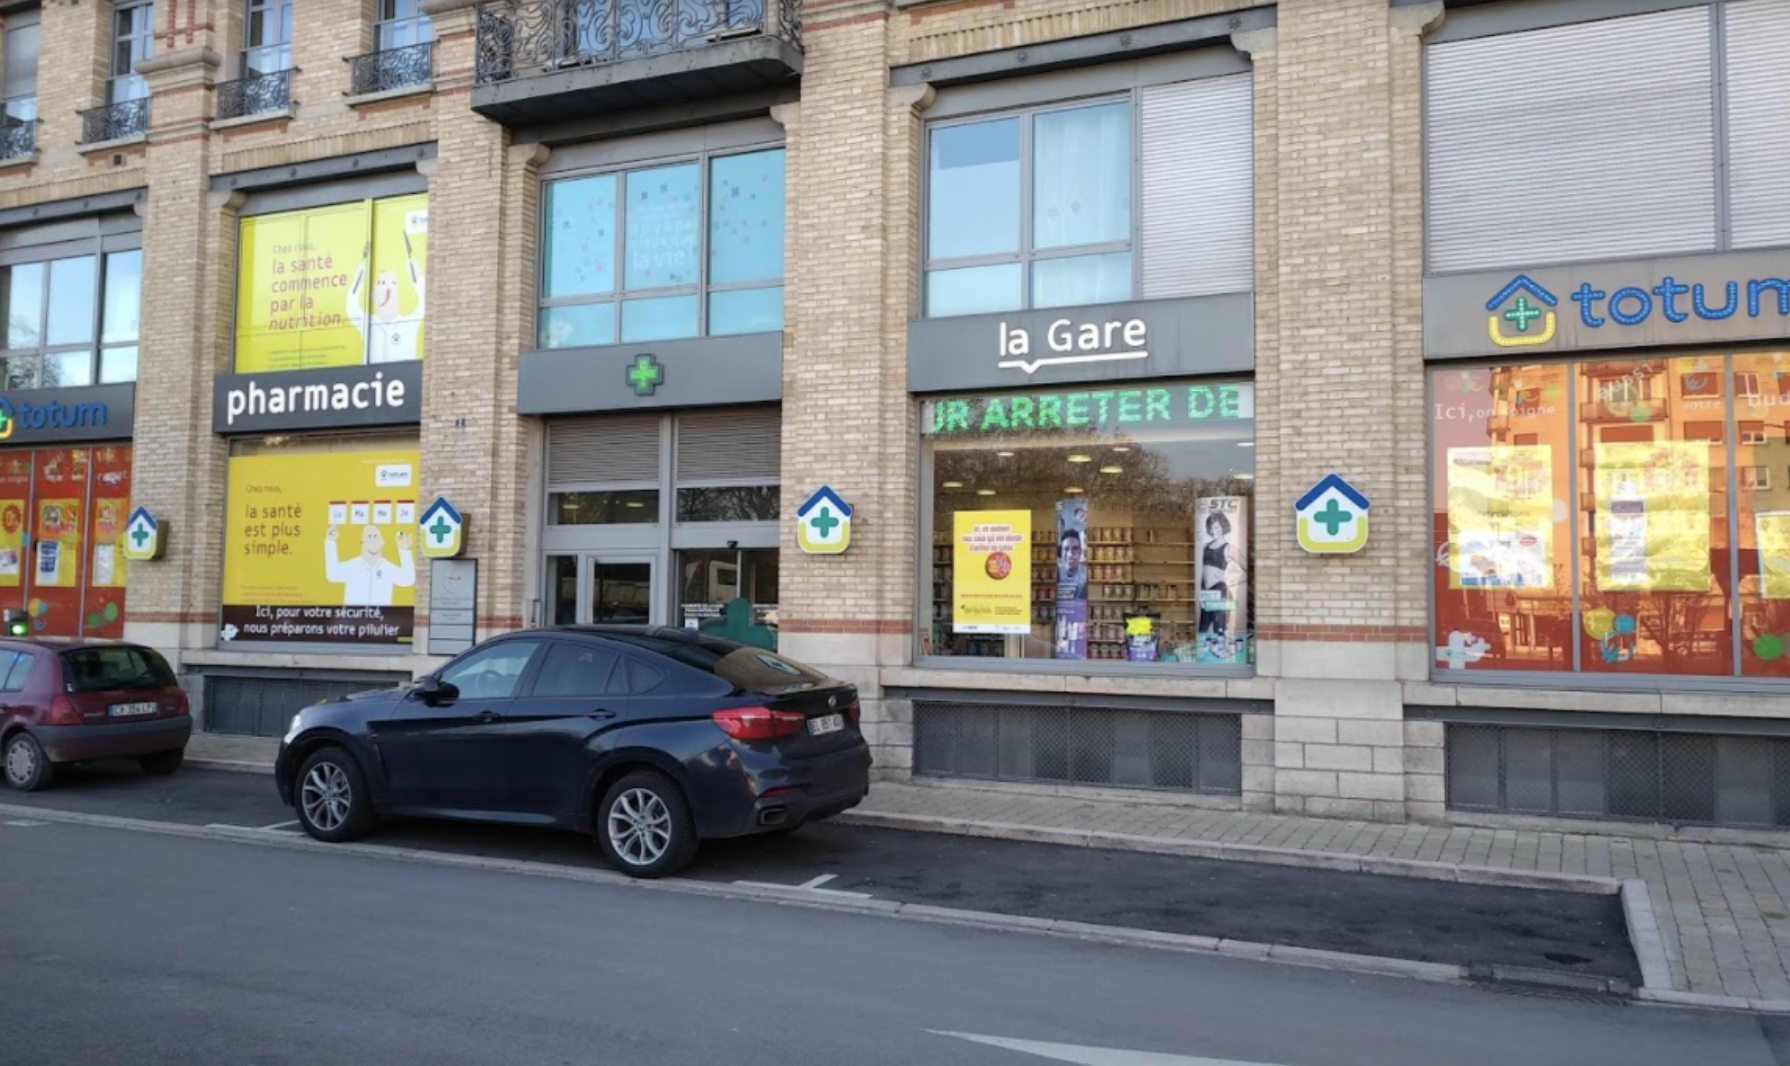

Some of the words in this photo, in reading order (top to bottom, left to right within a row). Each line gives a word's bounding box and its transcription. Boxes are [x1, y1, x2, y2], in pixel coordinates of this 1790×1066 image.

[272, 259, 284, 274] la
[290, 252, 332, 273] santé
[632, 251, 650, 270] la
[271, 274, 347, 293] commence
[270, 299, 295, 317] par
[300, 294, 313, 309] la
[269, 311, 345, 331] nutrition.
[999, 321, 1029, 357] la
[1047, 317, 1147, 352] Gare
[227, 371, 405, 425] pharmacie
[981, 388, 1172, 430] ARRETER
[1187, 384, 1240, 420] DE
[19, 400, 107, 429] totum
[1434, 402, 1473, 423] Ici,
[246, 503, 257, 518] la
[262, 502, 302, 519] santé
[245, 523, 266, 538] est
[272, 521, 301, 540] plus
[244, 540, 293, 559] simple.
[256, 605, 274, 620] Ici,
[276, 607, 301, 620] pour
[303, 606, 332, 618] votre
[335, 605, 384, 621] sécurité,
[243, 623, 268, 633] nous
[271, 621, 324, 637] préparons
[326, 624, 355, 635] votre
[358, 623, 400, 638] pilulier
